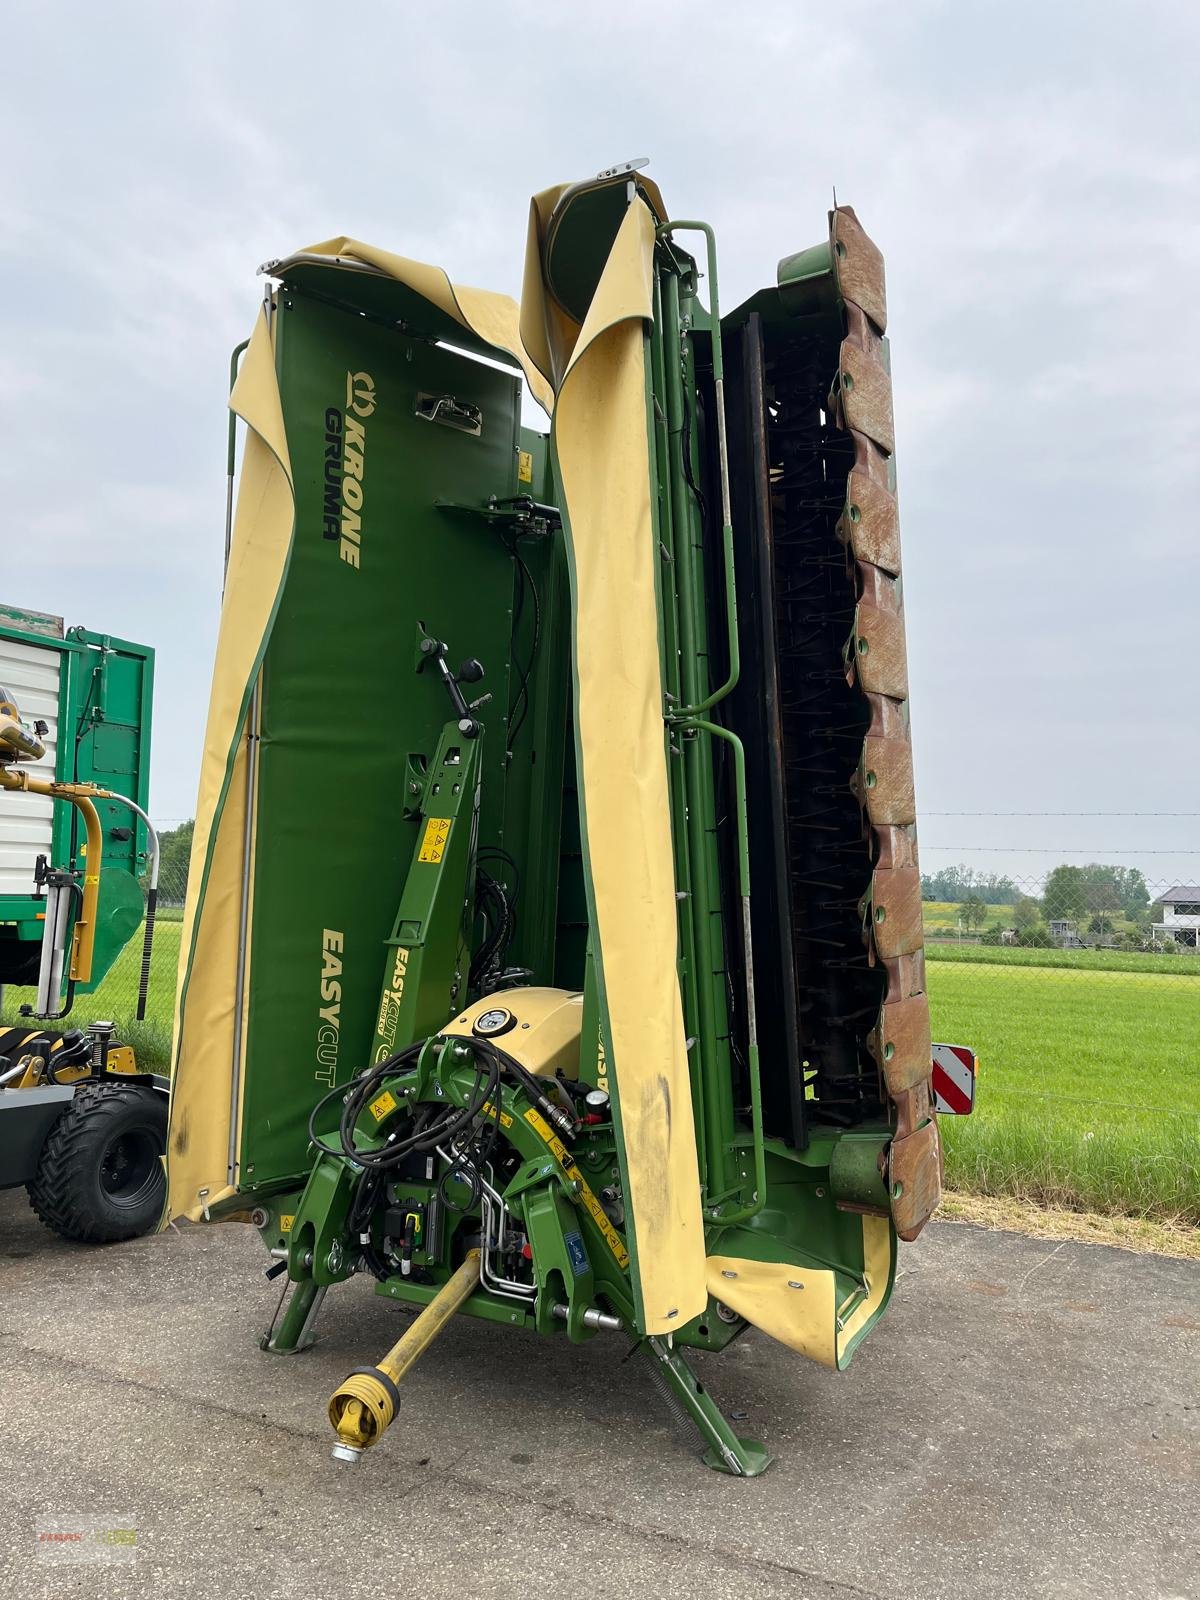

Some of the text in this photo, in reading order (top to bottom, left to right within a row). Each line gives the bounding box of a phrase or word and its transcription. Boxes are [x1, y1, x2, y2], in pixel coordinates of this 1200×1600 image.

[323, 407, 342, 541] GRUMA
[340, 415, 366, 569] KRONE
[315, 928, 344, 1089] EASYCUT
[384, 946, 409, 1047] EASYCUT
